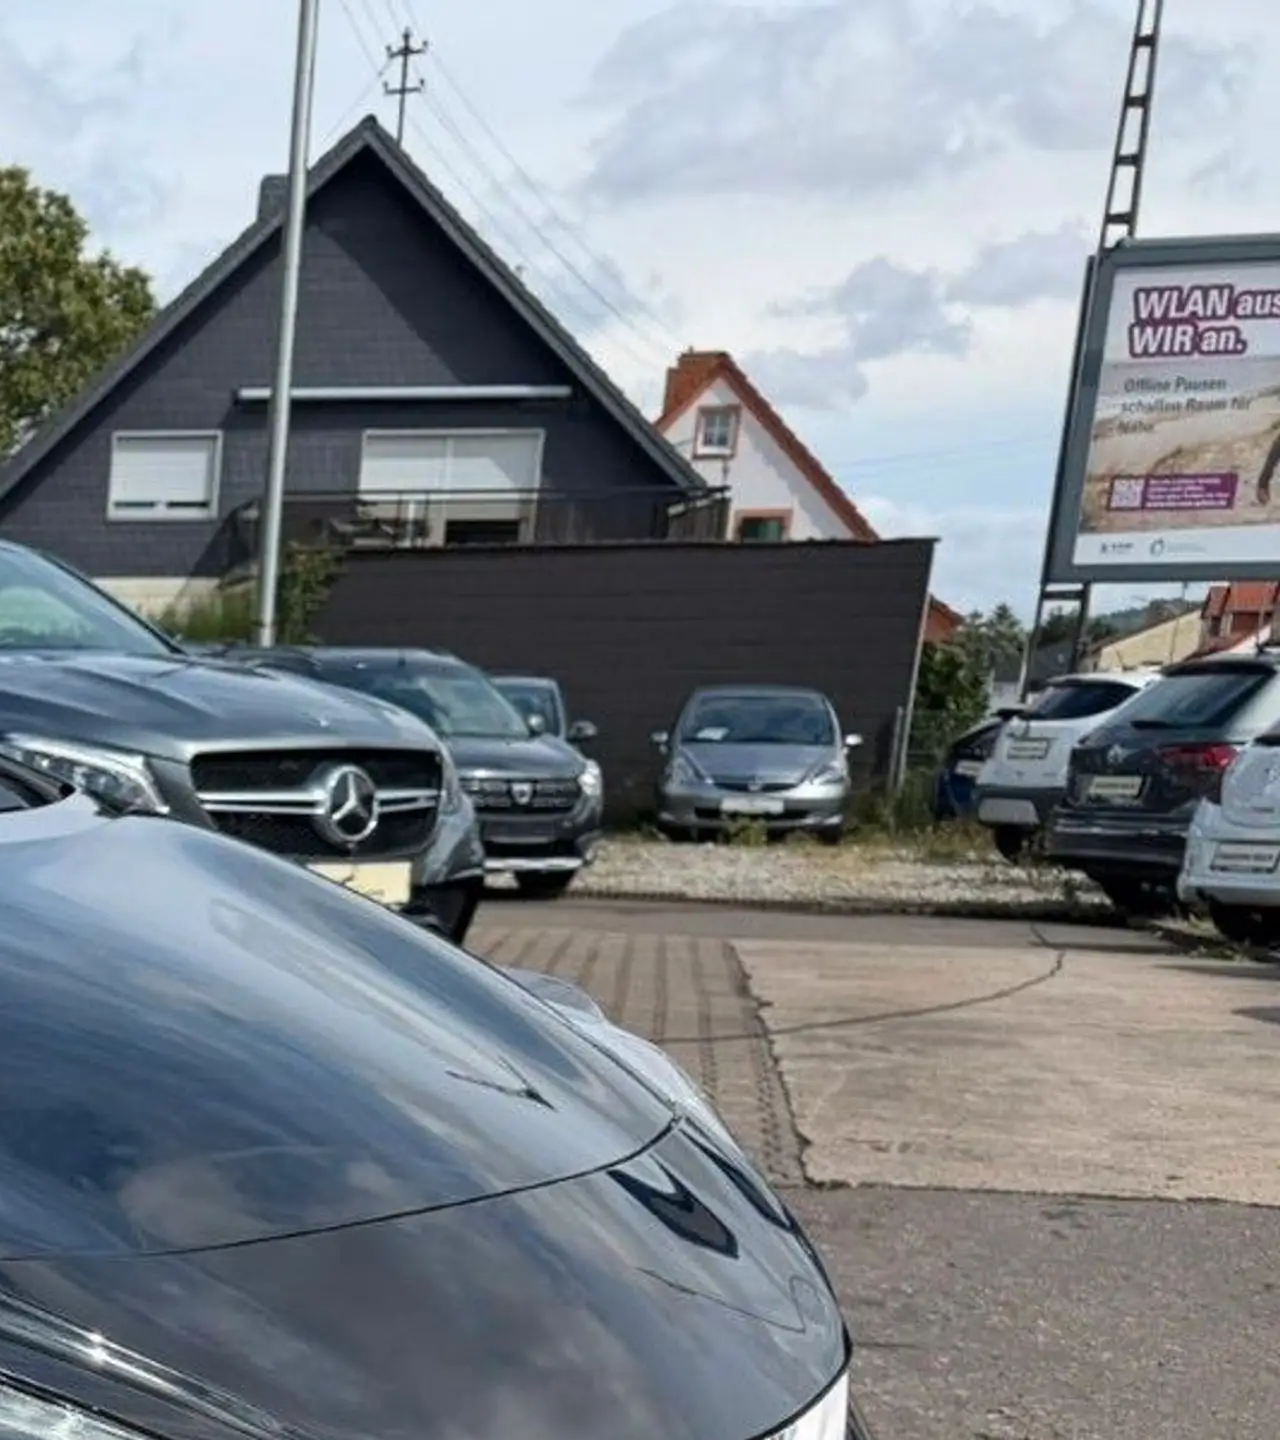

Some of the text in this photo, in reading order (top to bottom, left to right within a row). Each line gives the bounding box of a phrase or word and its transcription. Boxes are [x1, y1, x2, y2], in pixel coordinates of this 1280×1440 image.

[1136, 287, 1231, 320] WLAN
[1131, 324, 1244, 354] WIR an.
